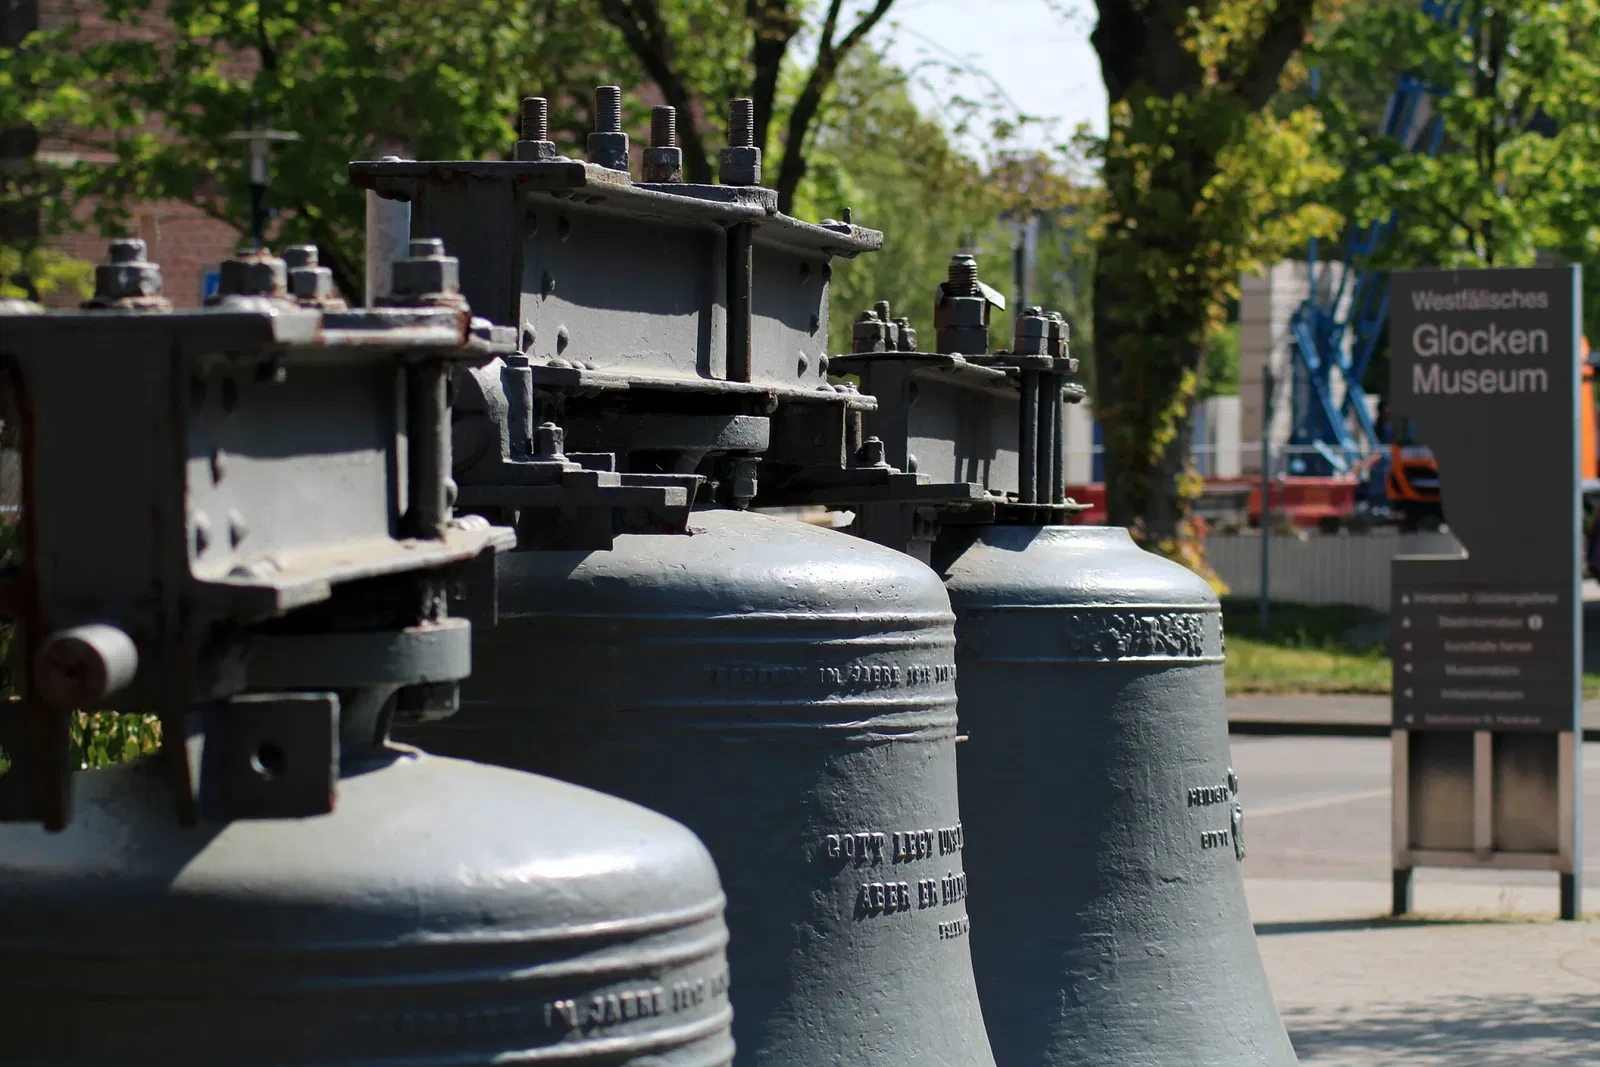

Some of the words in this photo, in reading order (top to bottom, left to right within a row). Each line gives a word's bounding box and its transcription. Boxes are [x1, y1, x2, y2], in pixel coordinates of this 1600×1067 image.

[1412, 288, 1549, 311] Westfälisches
[1412, 322, 1549, 357] Glocken
[1412, 362, 1549, 394] Museum
[827, 832, 884, 859] GOTT
[893, 829, 933, 858] LEGT
[859, 882, 910, 909] ABER
